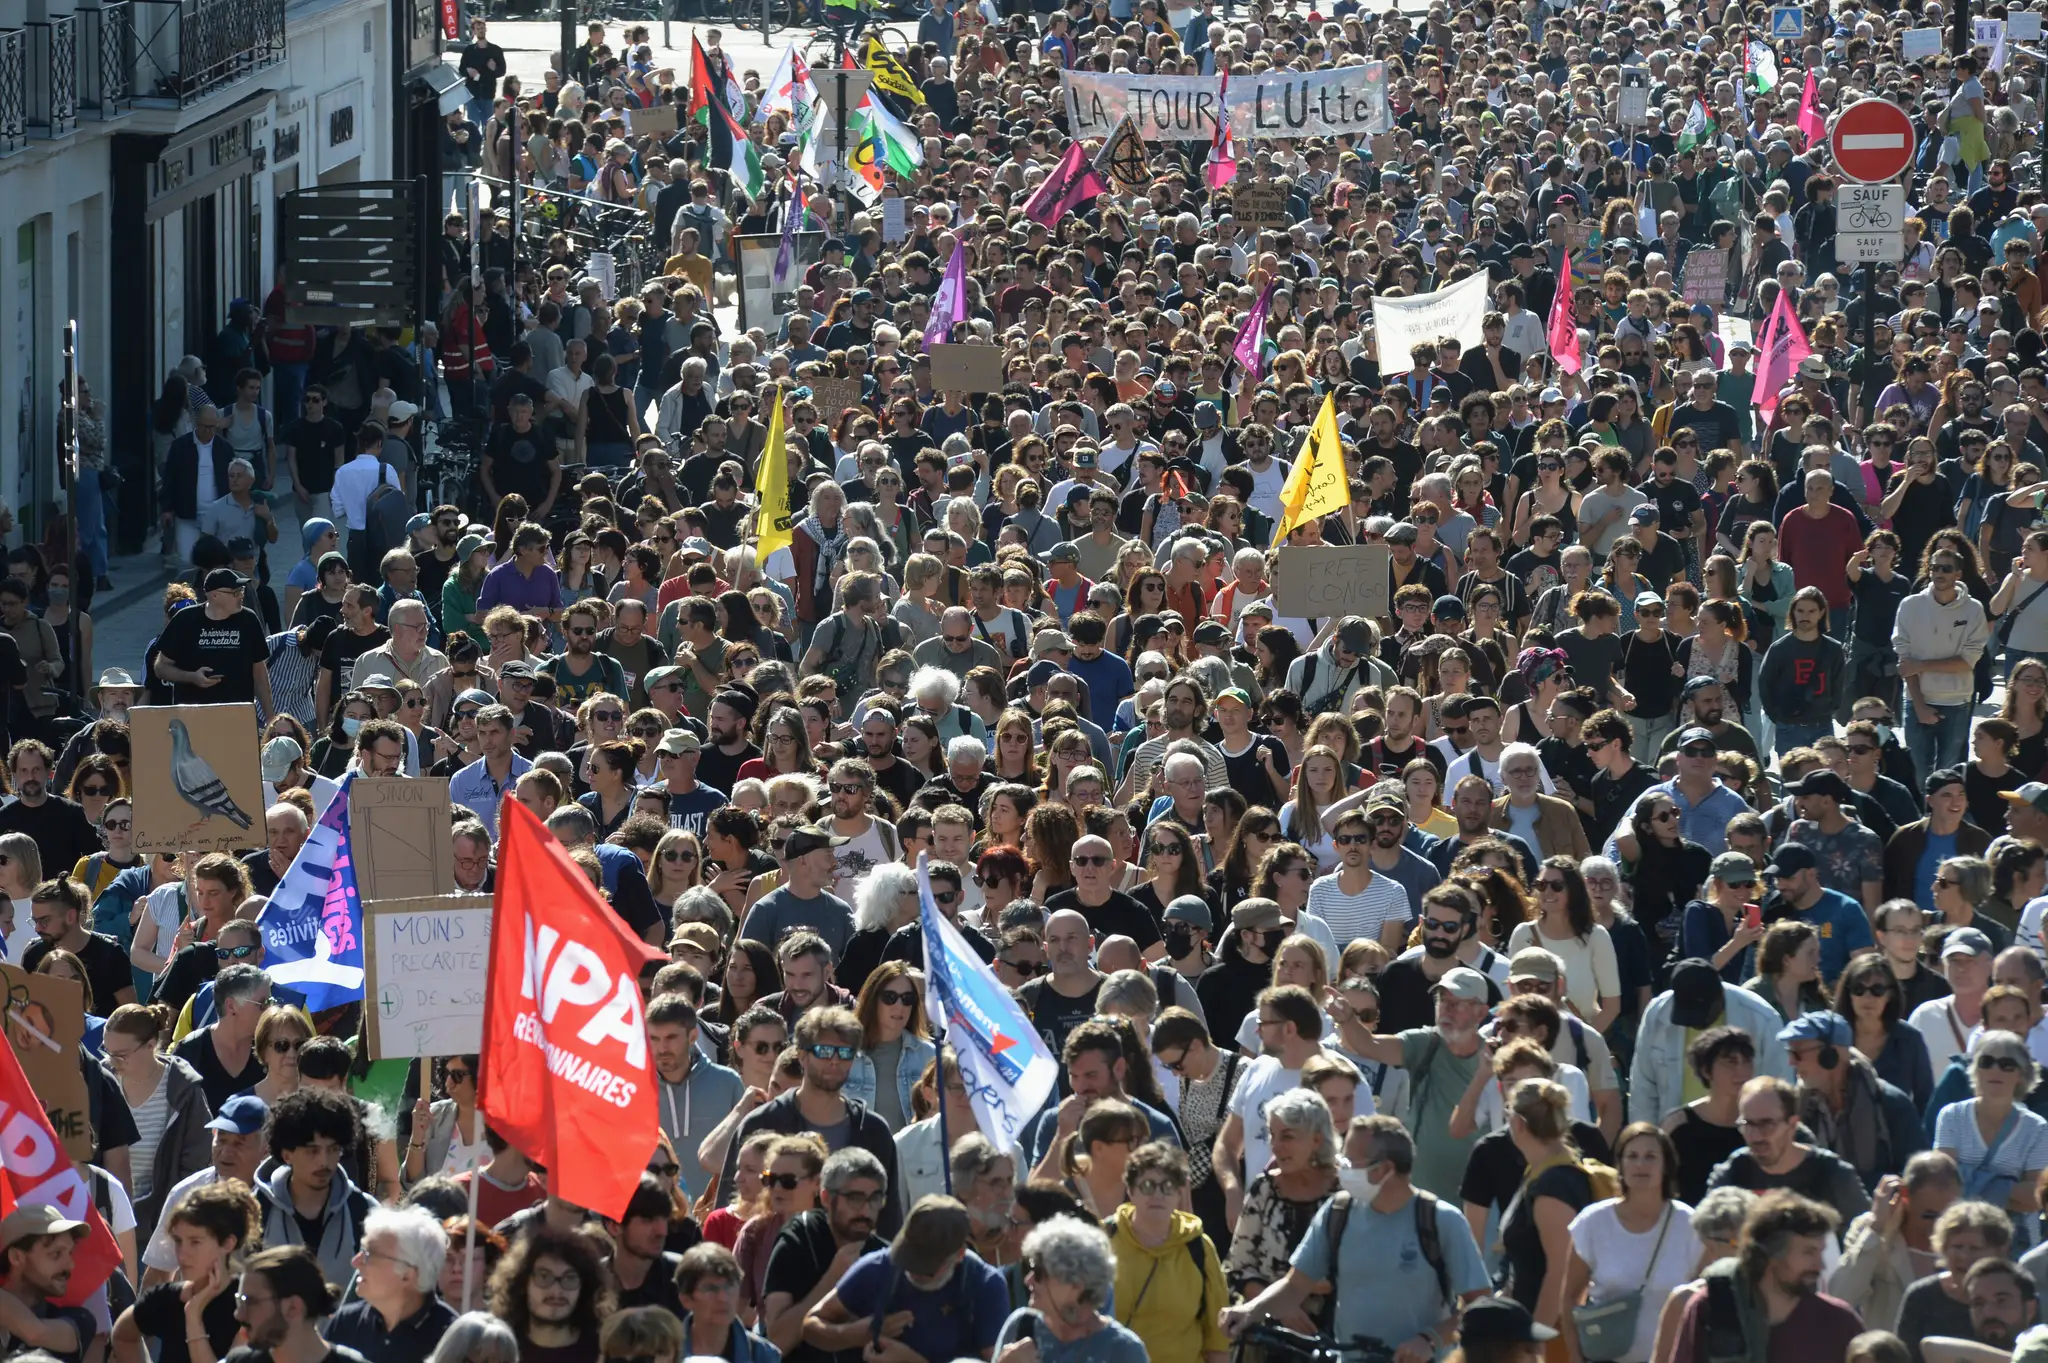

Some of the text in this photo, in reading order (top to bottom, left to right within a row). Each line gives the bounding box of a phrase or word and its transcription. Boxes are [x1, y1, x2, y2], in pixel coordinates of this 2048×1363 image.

[1071, 79, 1370, 131] LA TOUR LU-tte
[1853, 189, 1890, 201] SAUF
[1856, 238, 1884, 246] SAUF
[1859, 249, 1880, 257] BUS
[1308, 558, 1372, 577] FREE
[1307, 582, 1386, 605] CONGO
[198, 636, 241, 646] en retard
[375, 784, 424, 803] SINON
[135, 831, 153, 849] Ceci
[179, 839, 193, 852] pas
[215, 835, 245, 853] pigeon
[392, 915, 465, 946] MOINS
[417, 989, 438, 1008] DE
